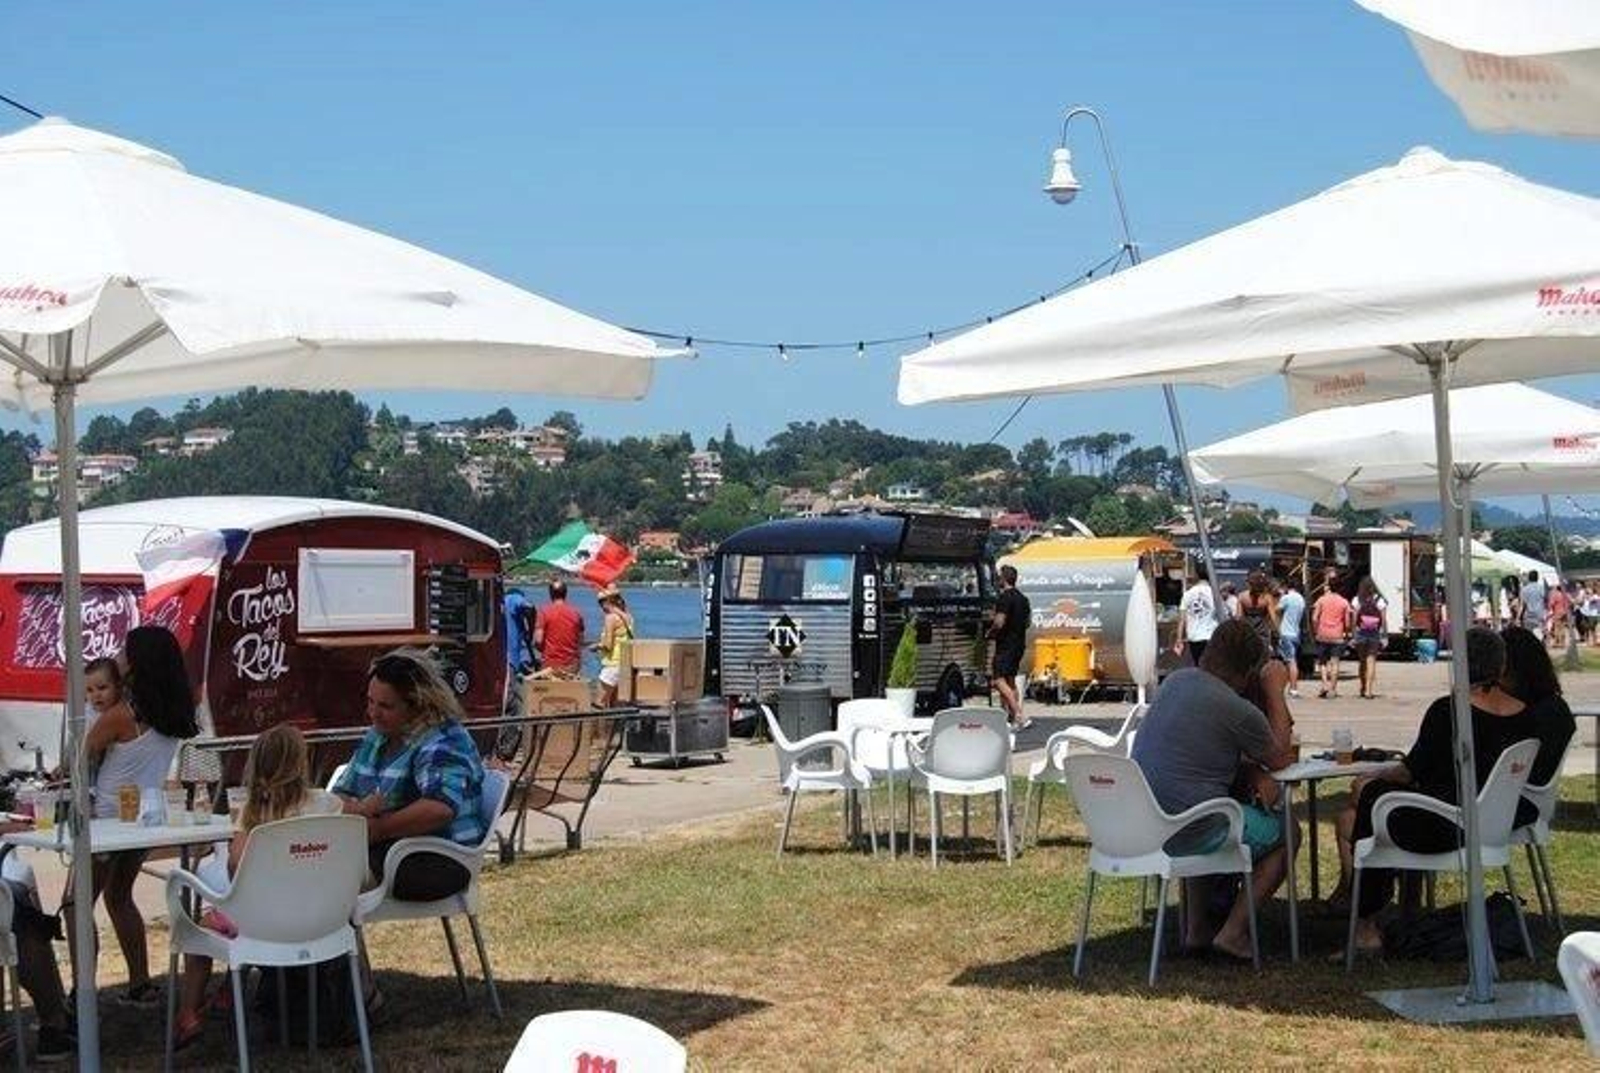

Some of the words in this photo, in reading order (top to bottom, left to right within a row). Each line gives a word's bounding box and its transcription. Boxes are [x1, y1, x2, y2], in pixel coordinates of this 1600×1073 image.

[227, 583, 295, 628] Tacos
[232, 633, 290, 681] Rey
[769, 626, 801, 646] TN
